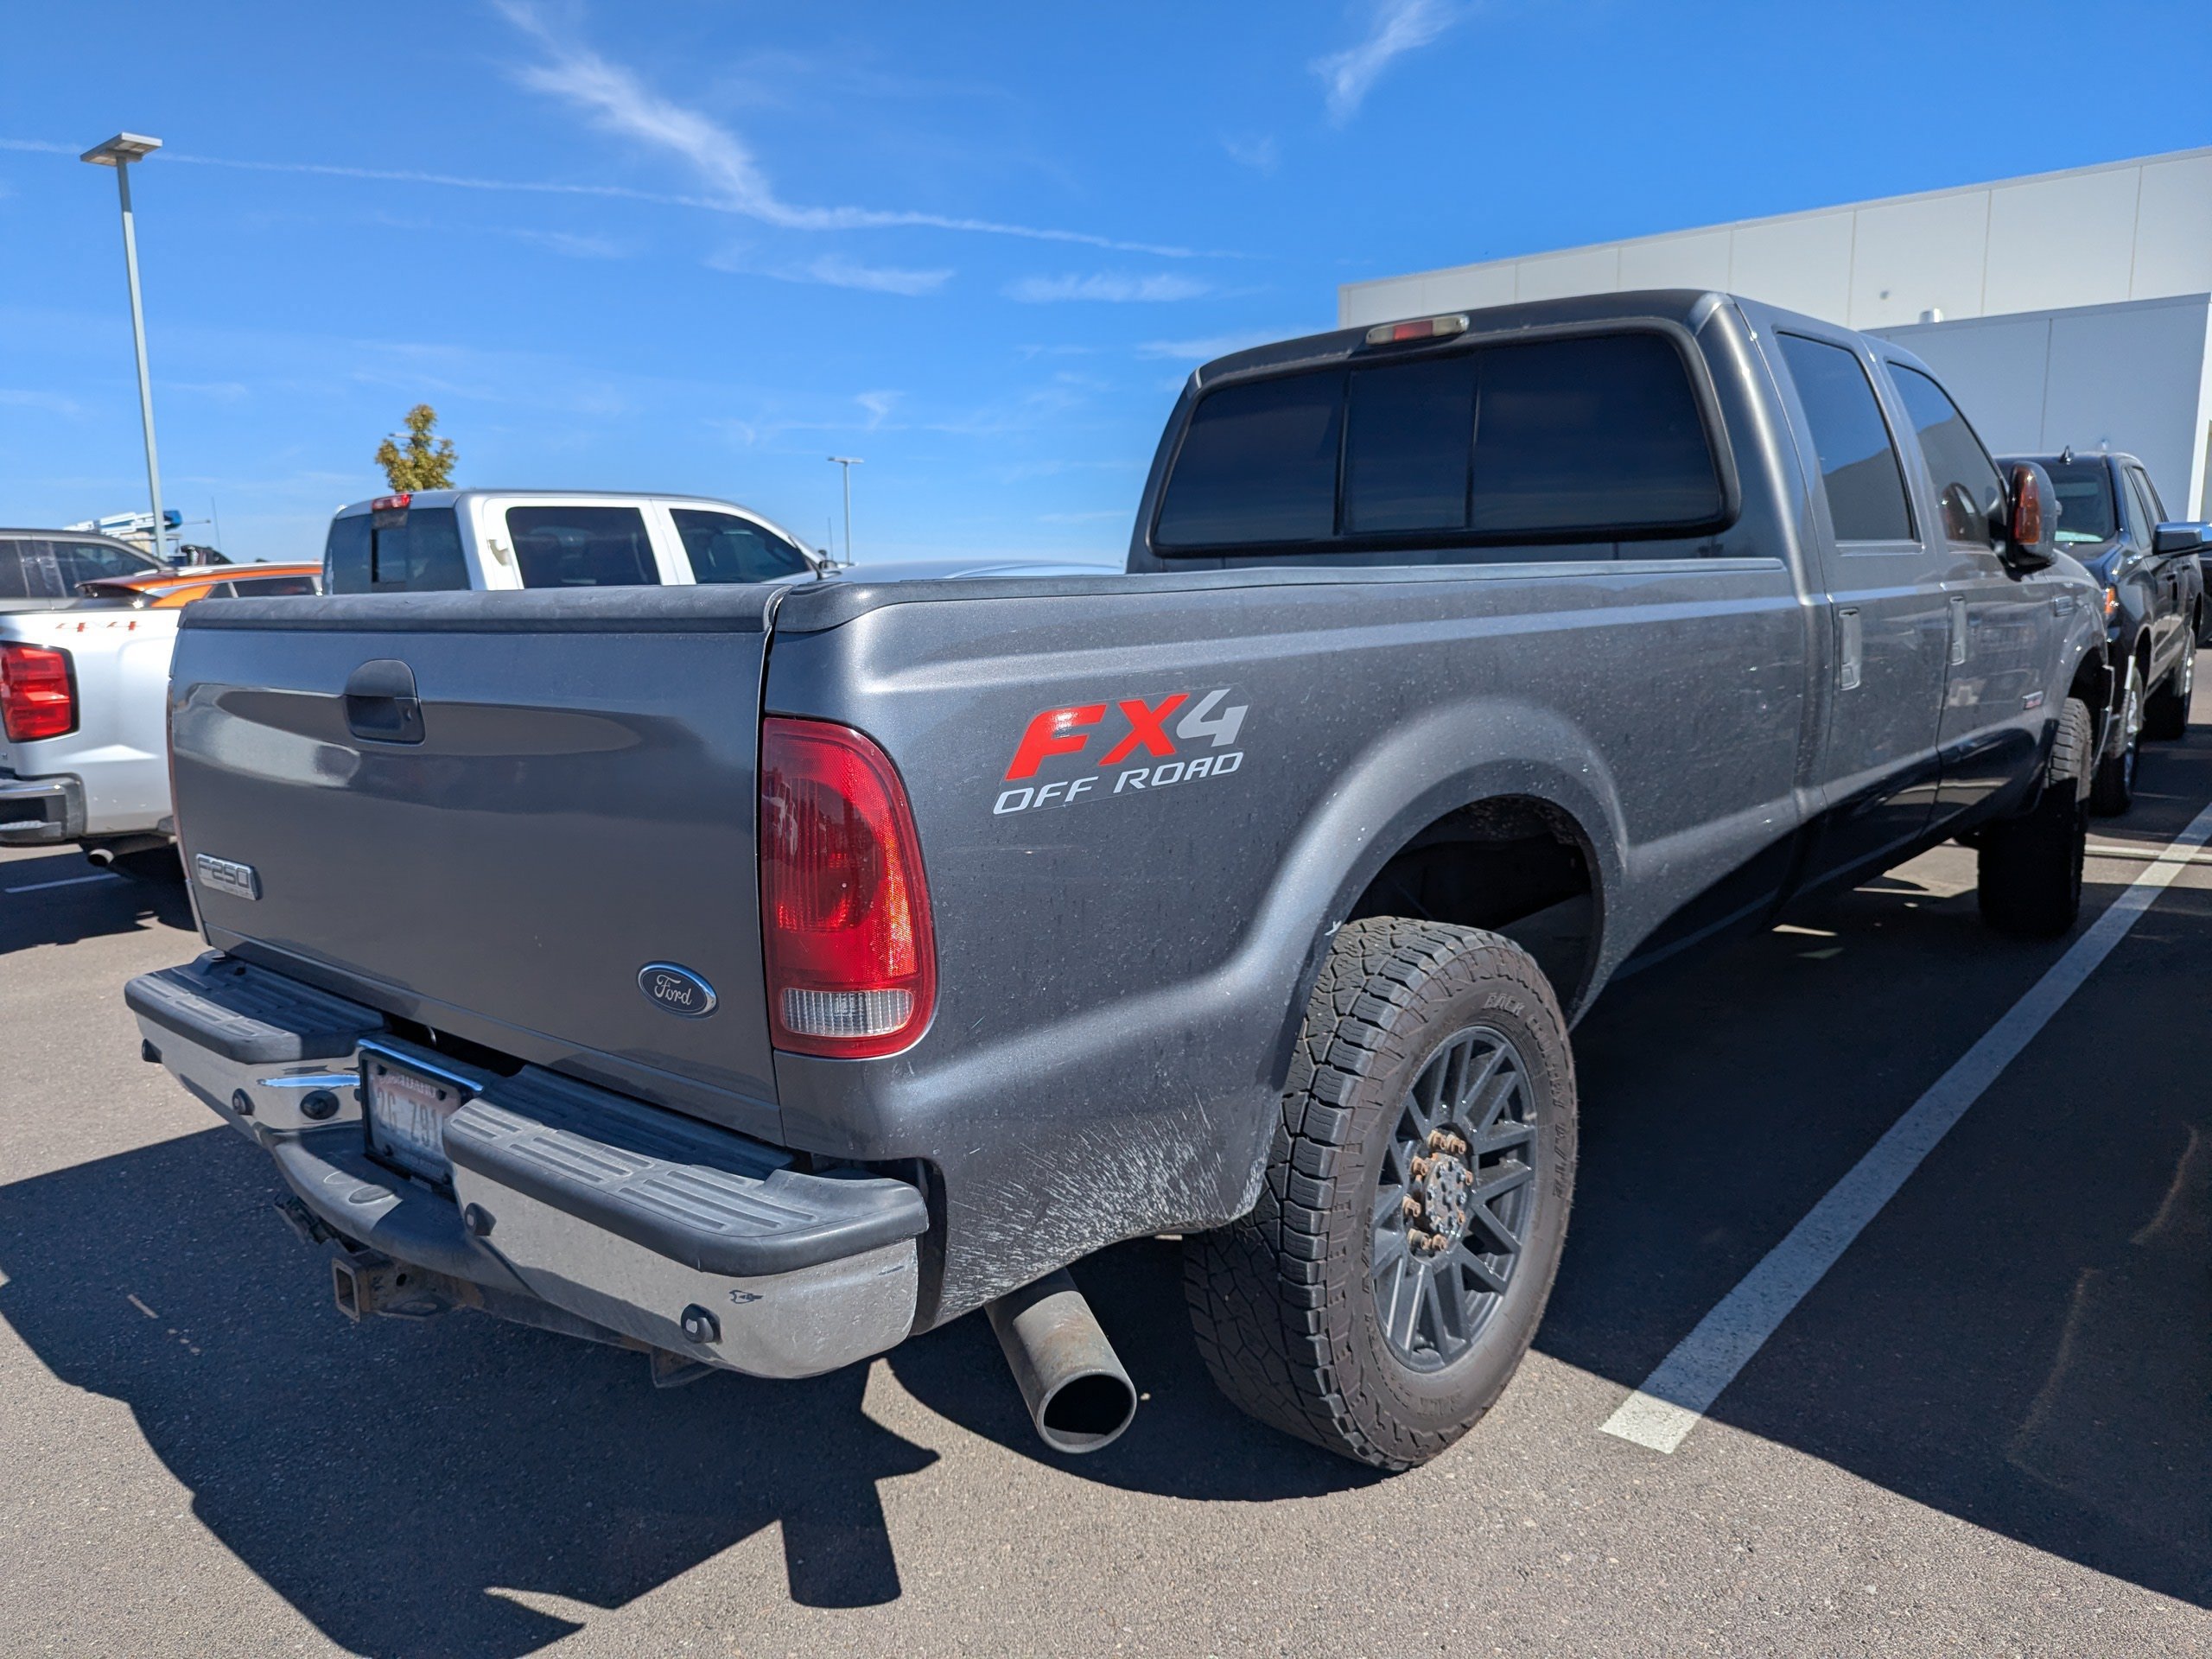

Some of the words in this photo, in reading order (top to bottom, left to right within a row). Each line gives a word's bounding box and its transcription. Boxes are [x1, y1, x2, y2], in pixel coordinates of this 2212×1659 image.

[1004, 689, 1249, 781] FX4
[993, 776, 1099, 815] OFF
[1113, 752, 1244, 794] ROAD
[654, 974, 692, 1006] Ford
